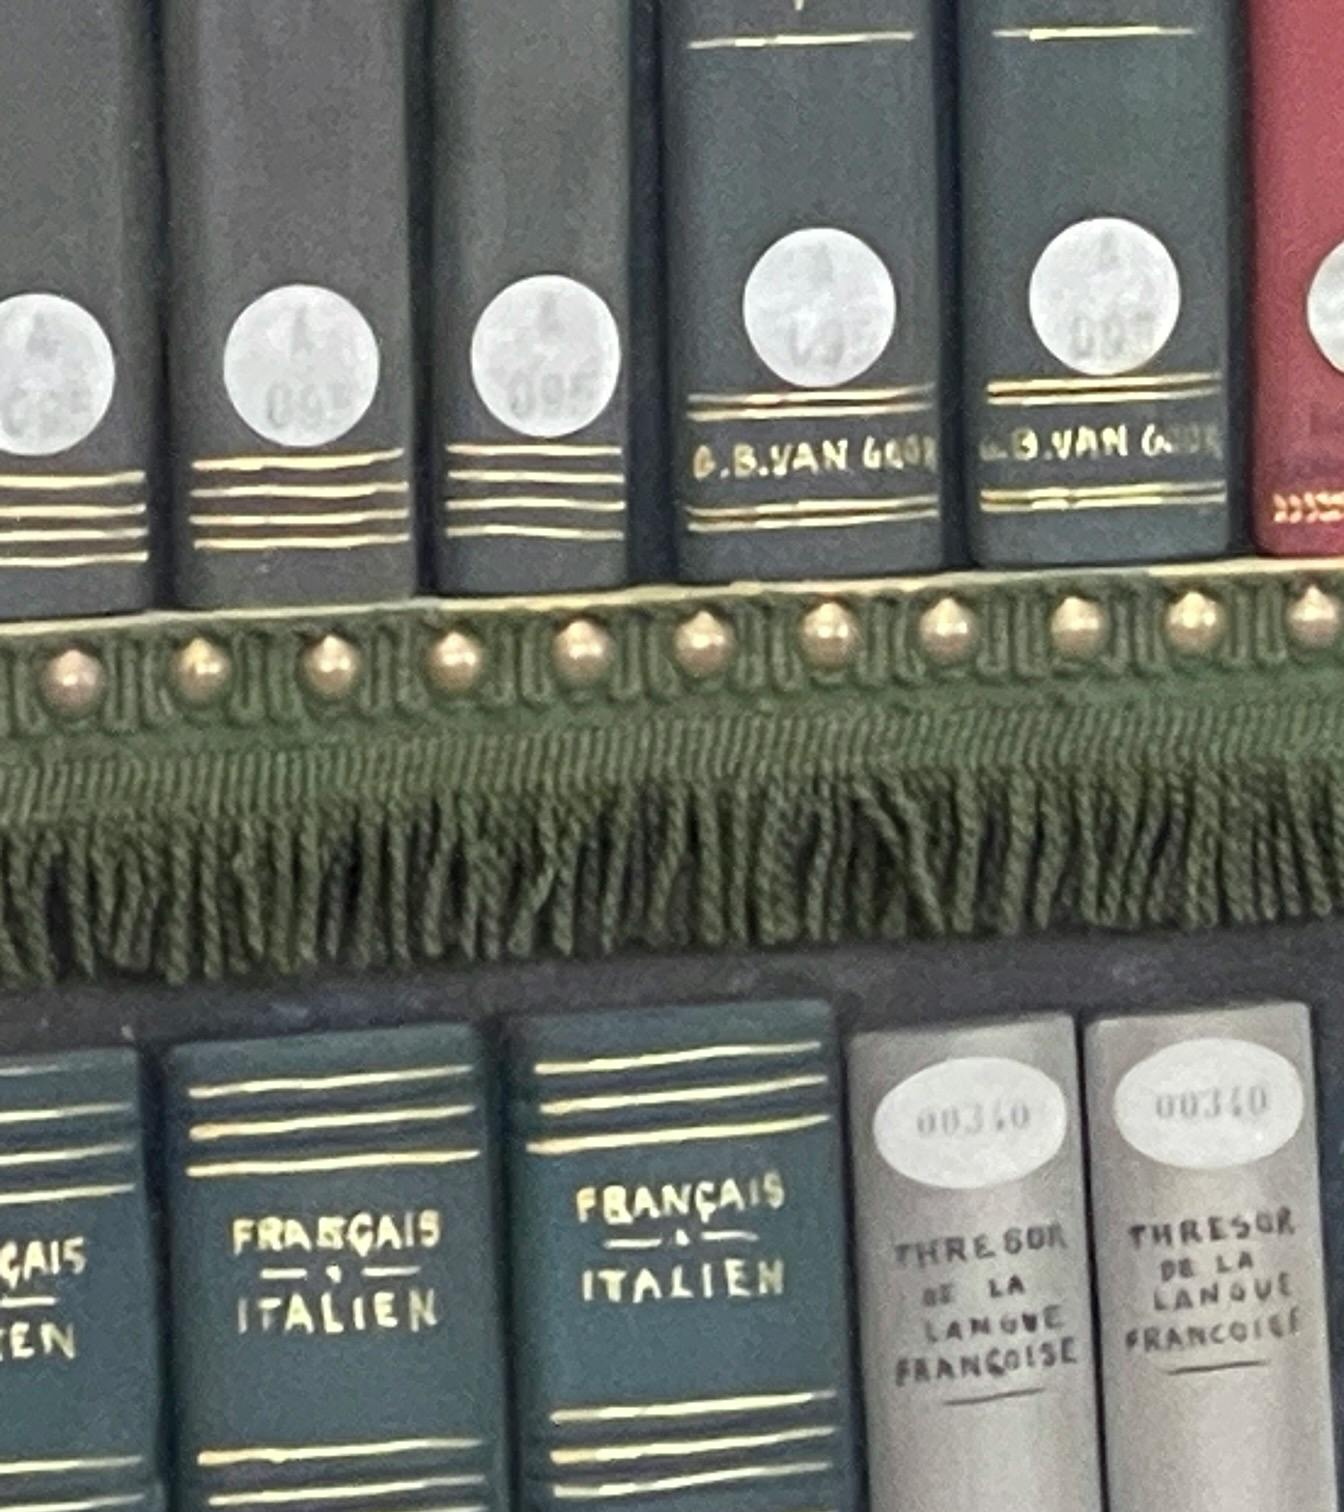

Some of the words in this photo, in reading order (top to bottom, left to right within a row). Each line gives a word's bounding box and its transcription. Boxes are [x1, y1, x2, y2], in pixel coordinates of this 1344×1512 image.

[575, 1170, 786, 1225] FRANÇAIS
[231, 1208, 441, 1257] FRANÇAIS
[1127, 1206, 1297, 1251] THRESOR
[582, 1258, 785, 1303] ITALIEN
[988, 1274, 1027, 1298] LA
[1160, 1259, 1195, 1284] DE
[1216, 1250, 1255, 1275] LA
[236, 1286, 438, 1335] ITALIEN
